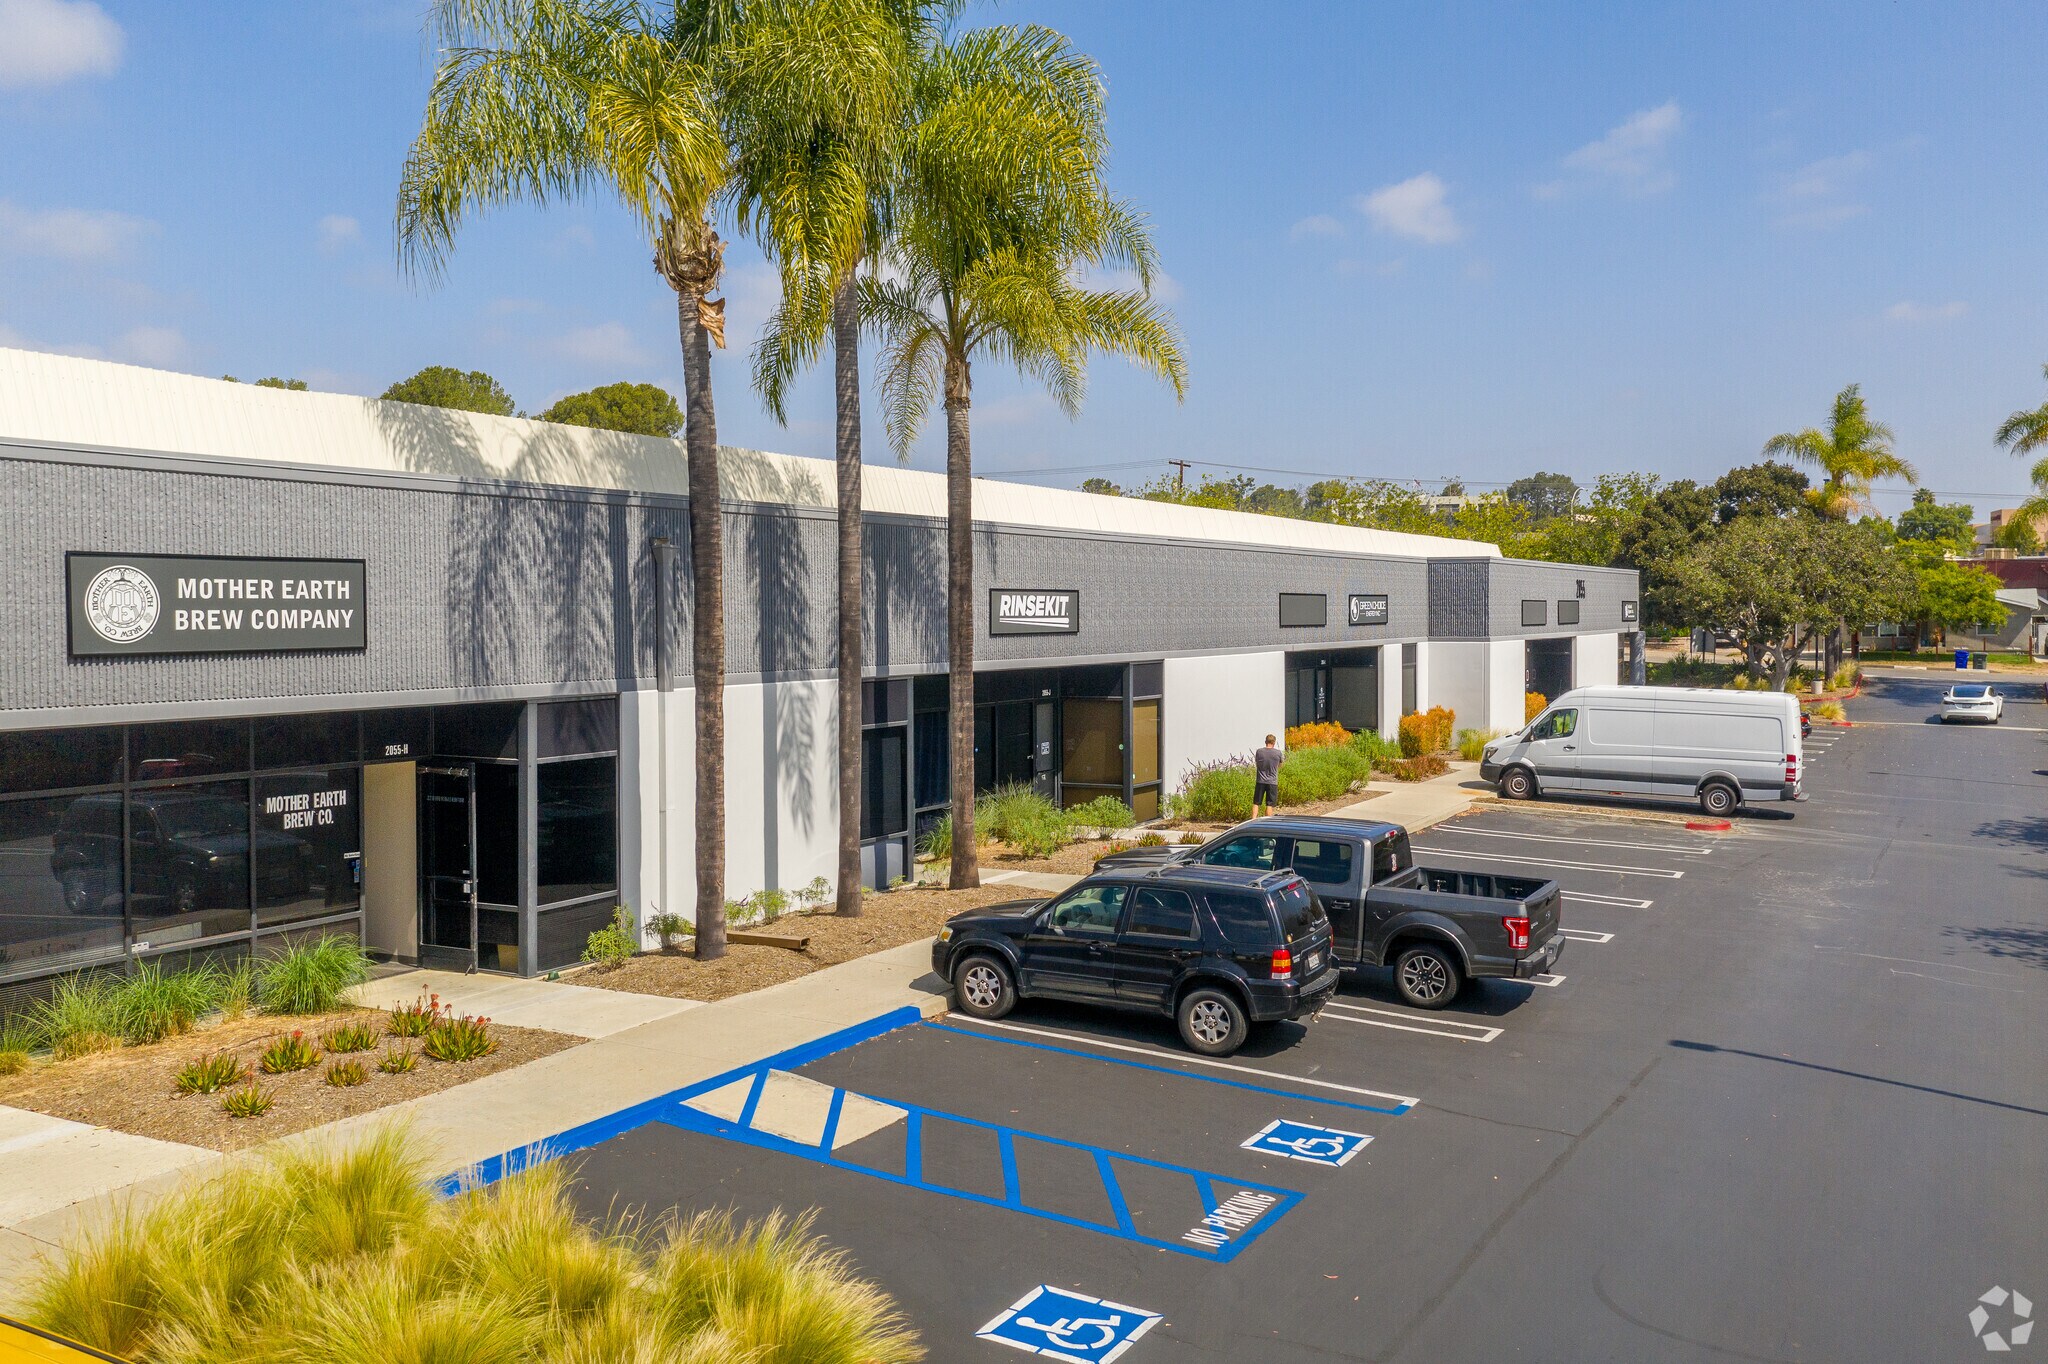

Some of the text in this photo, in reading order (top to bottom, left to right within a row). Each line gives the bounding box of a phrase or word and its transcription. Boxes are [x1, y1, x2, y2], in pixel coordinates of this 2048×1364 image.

[138, 580, 154, 607] EARTH
[177, 578, 350, 600] MOTHER EARTH
[175, 608, 354, 631] BREW COMPANY
[120, 625, 143, 638] BREW
[266, 789, 347, 814] MOTHER EARTH
[283, 808, 335, 830] BREW CO.
[1181, 1191, 1277, 1248] NO PARKING
